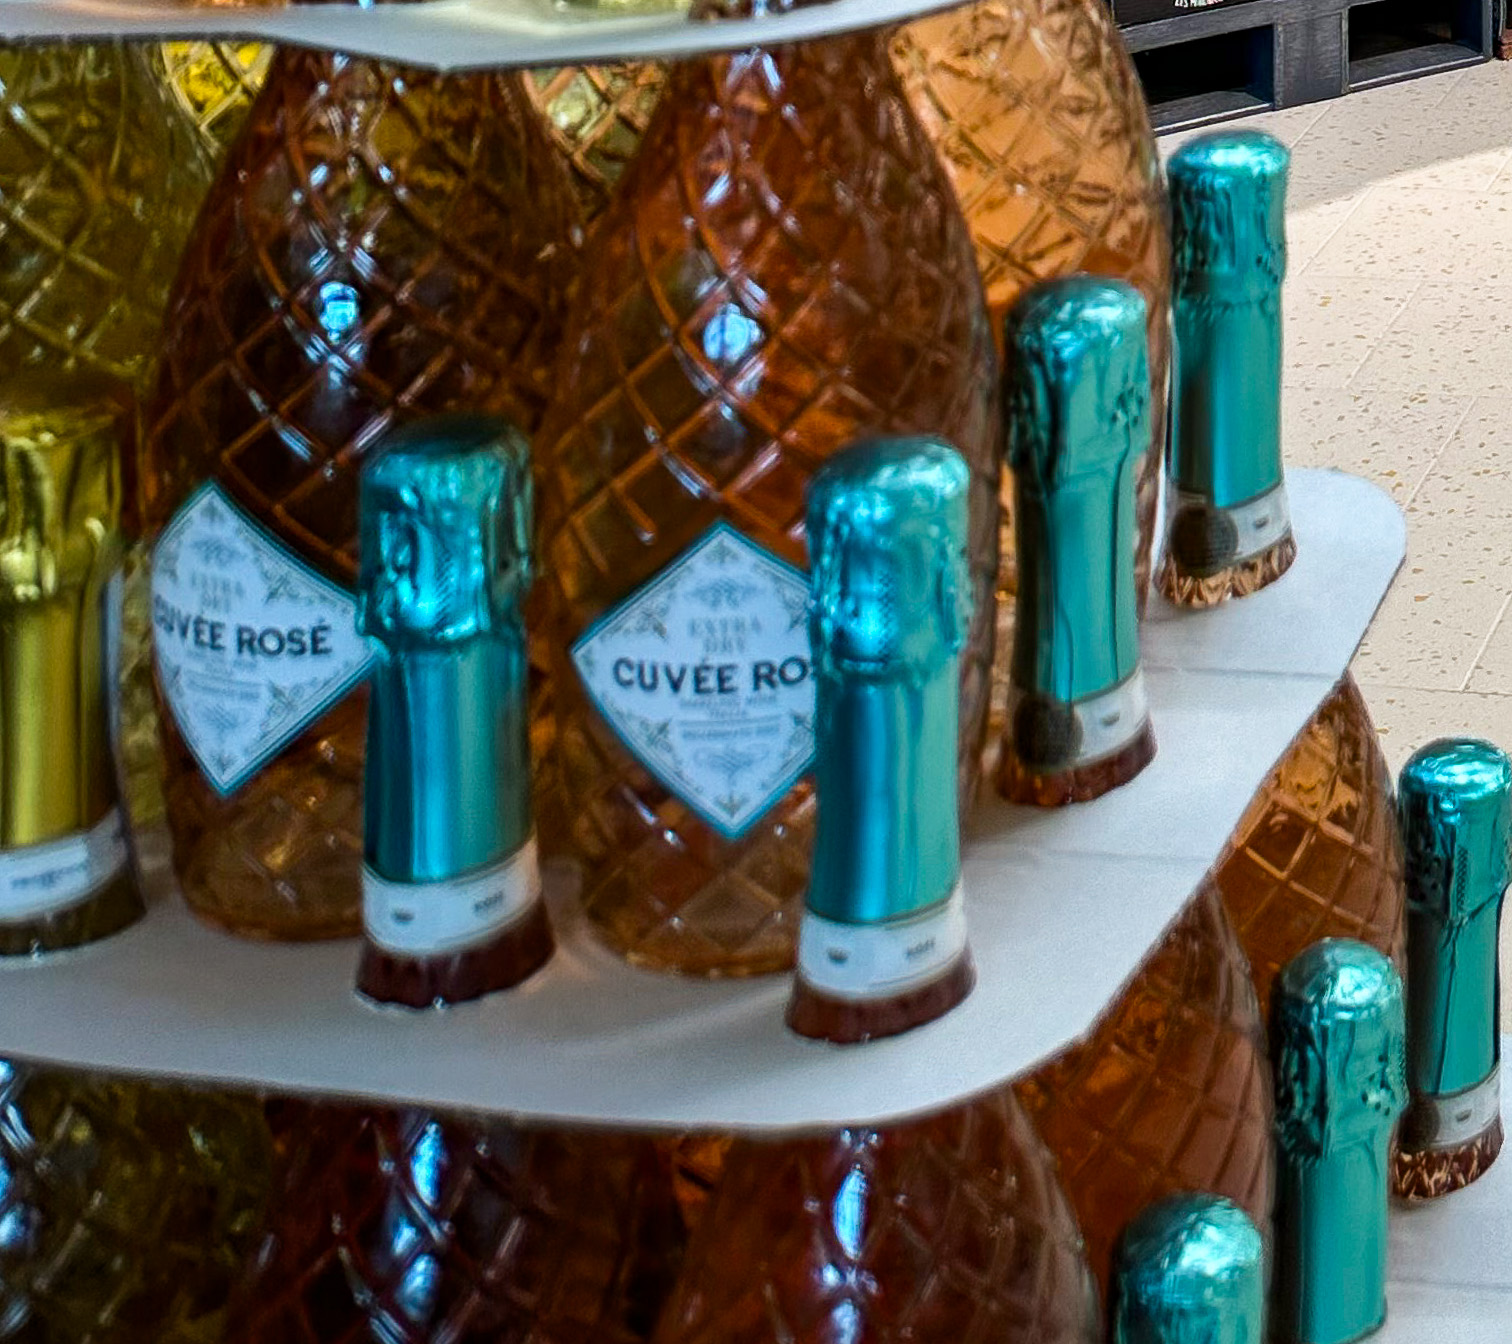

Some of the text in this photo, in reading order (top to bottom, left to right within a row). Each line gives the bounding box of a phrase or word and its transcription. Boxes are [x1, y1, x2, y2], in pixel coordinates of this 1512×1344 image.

[236, 616, 333, 656] ROSÉ
[612, 655, 810, 695] CUVÉE RO
